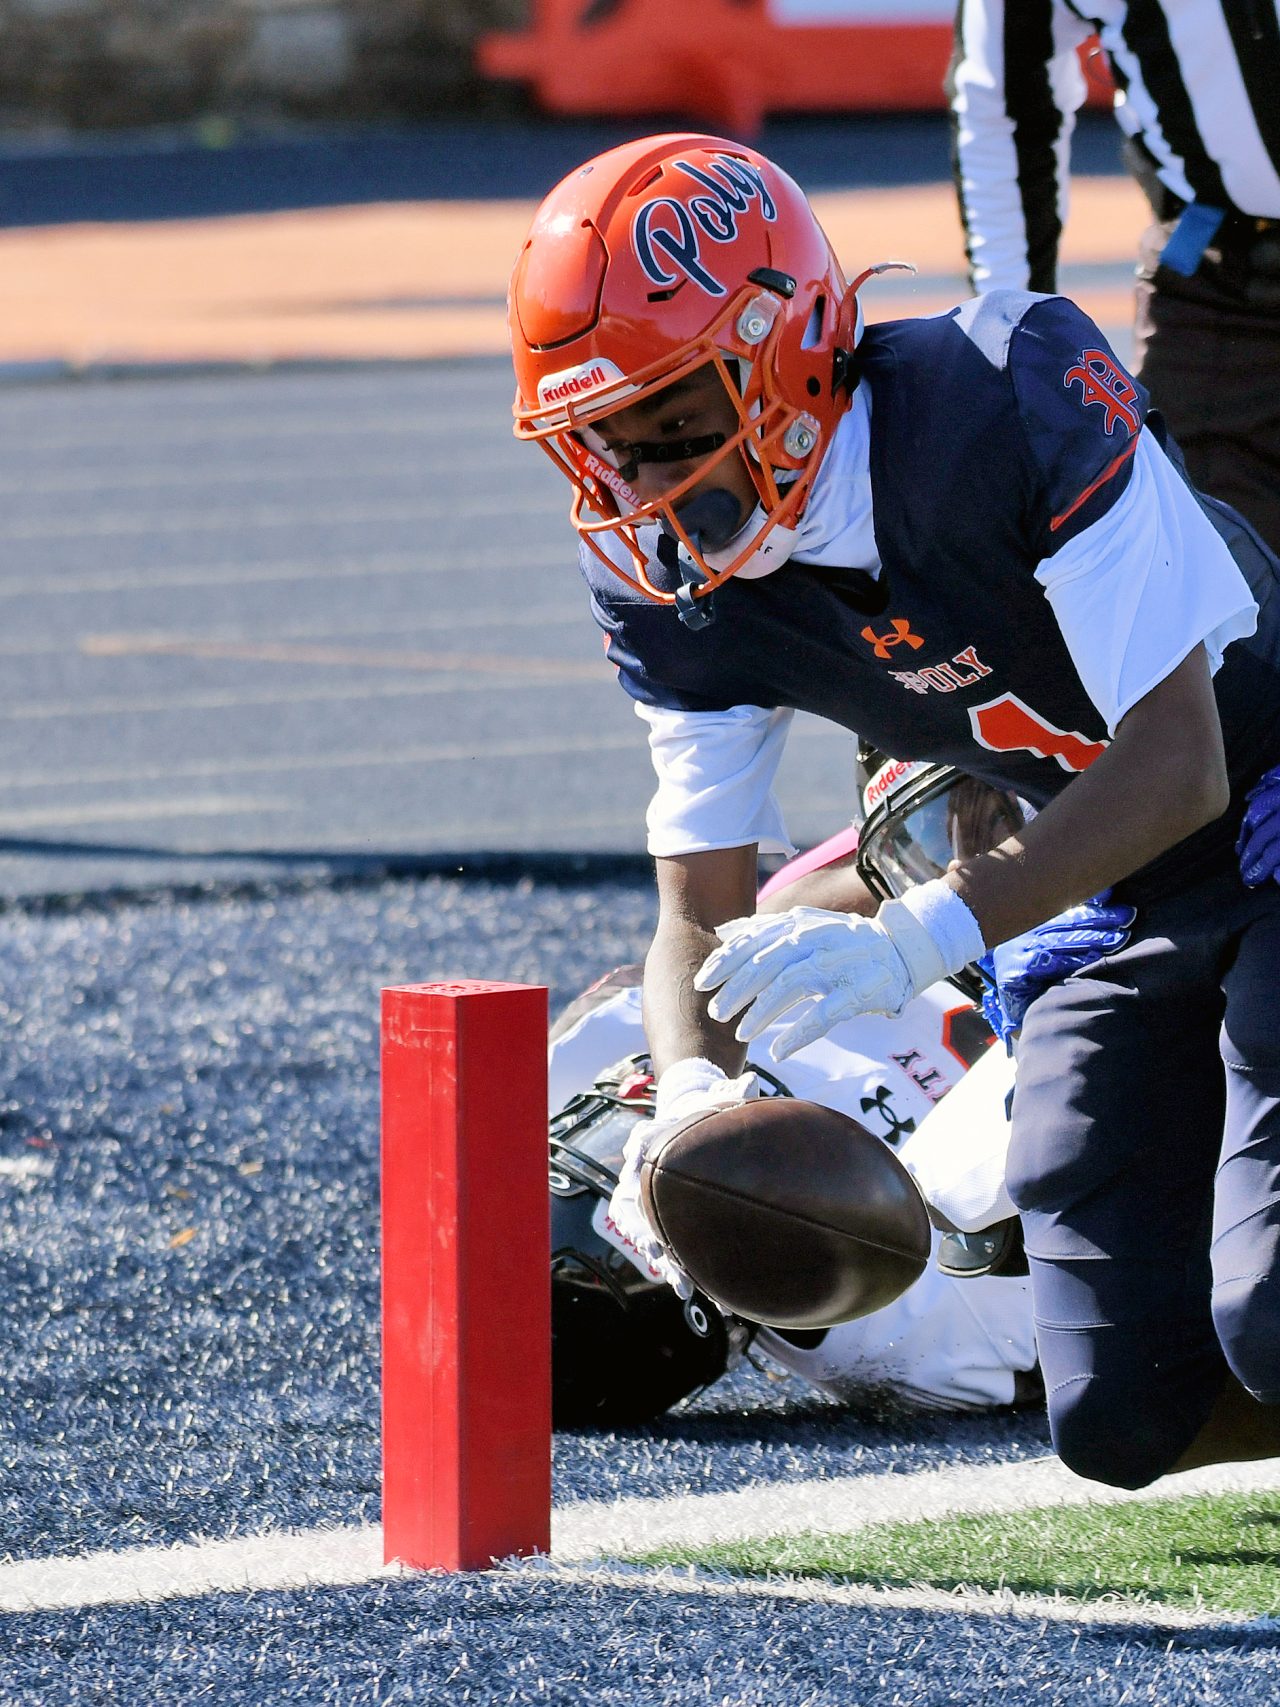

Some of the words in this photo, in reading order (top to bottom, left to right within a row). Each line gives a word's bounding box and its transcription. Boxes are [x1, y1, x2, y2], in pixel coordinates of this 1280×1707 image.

[633, 154, 777, 298] Poly
[542, 365, 606, 403] Riddell
[888, 645, 993, 694] POLY
